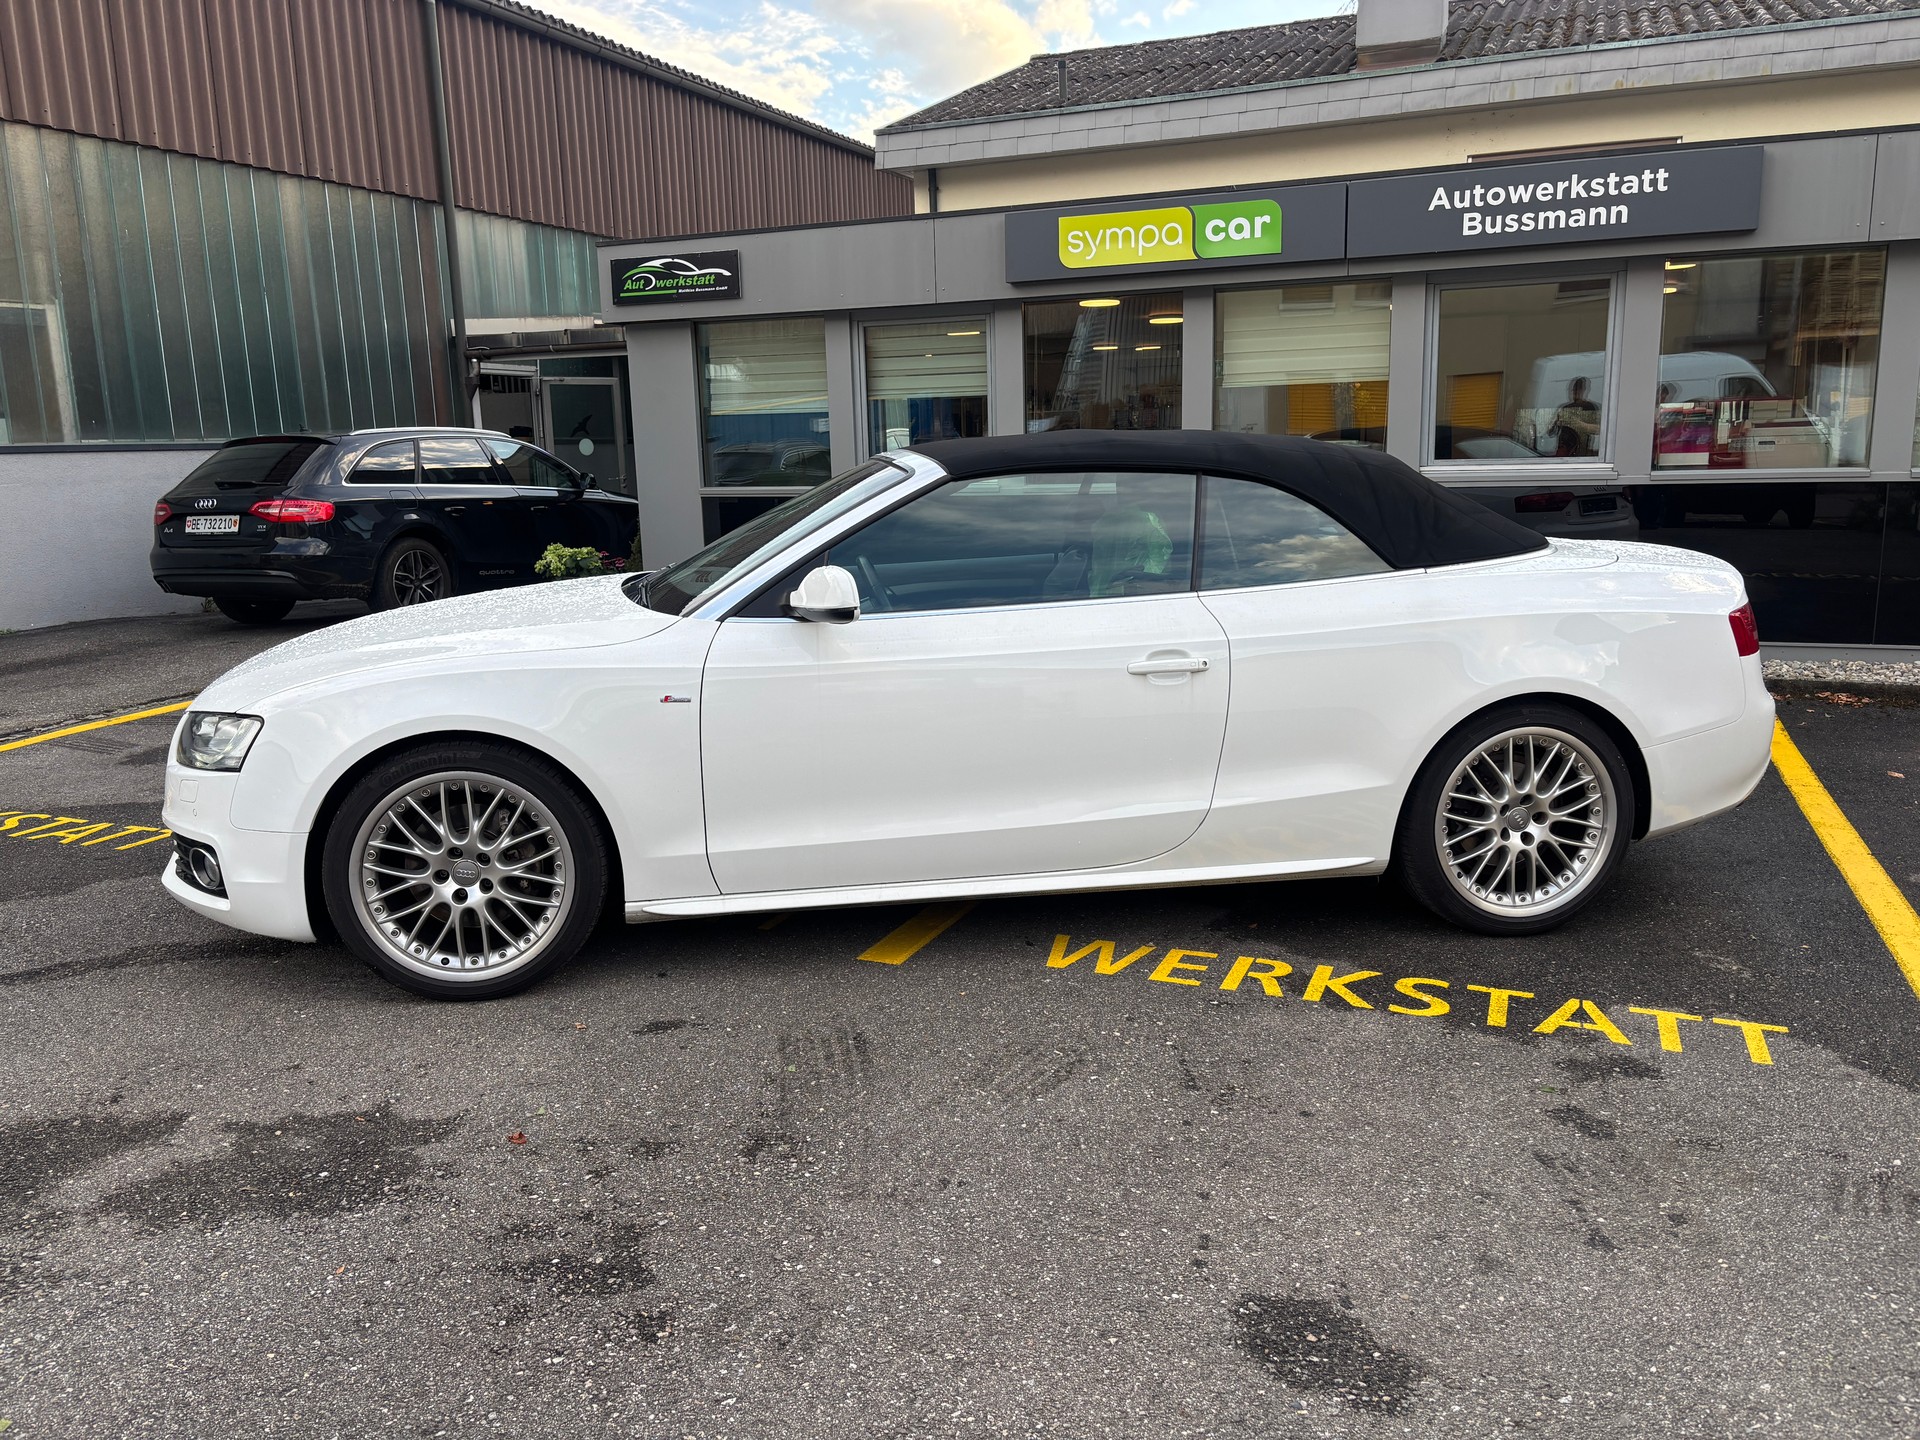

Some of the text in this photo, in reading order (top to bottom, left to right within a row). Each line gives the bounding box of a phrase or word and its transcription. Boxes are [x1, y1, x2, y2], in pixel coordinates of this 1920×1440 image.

[1428, 168, 1670, 212] Autowerkstatt
[1067, 214, 1271, 260] sympa car
[1462, 204, 1629, 236] Bussmann
[0, 811, 173, 850] STATT
[1046, 934, 1790, 1066] WERKSTATT
